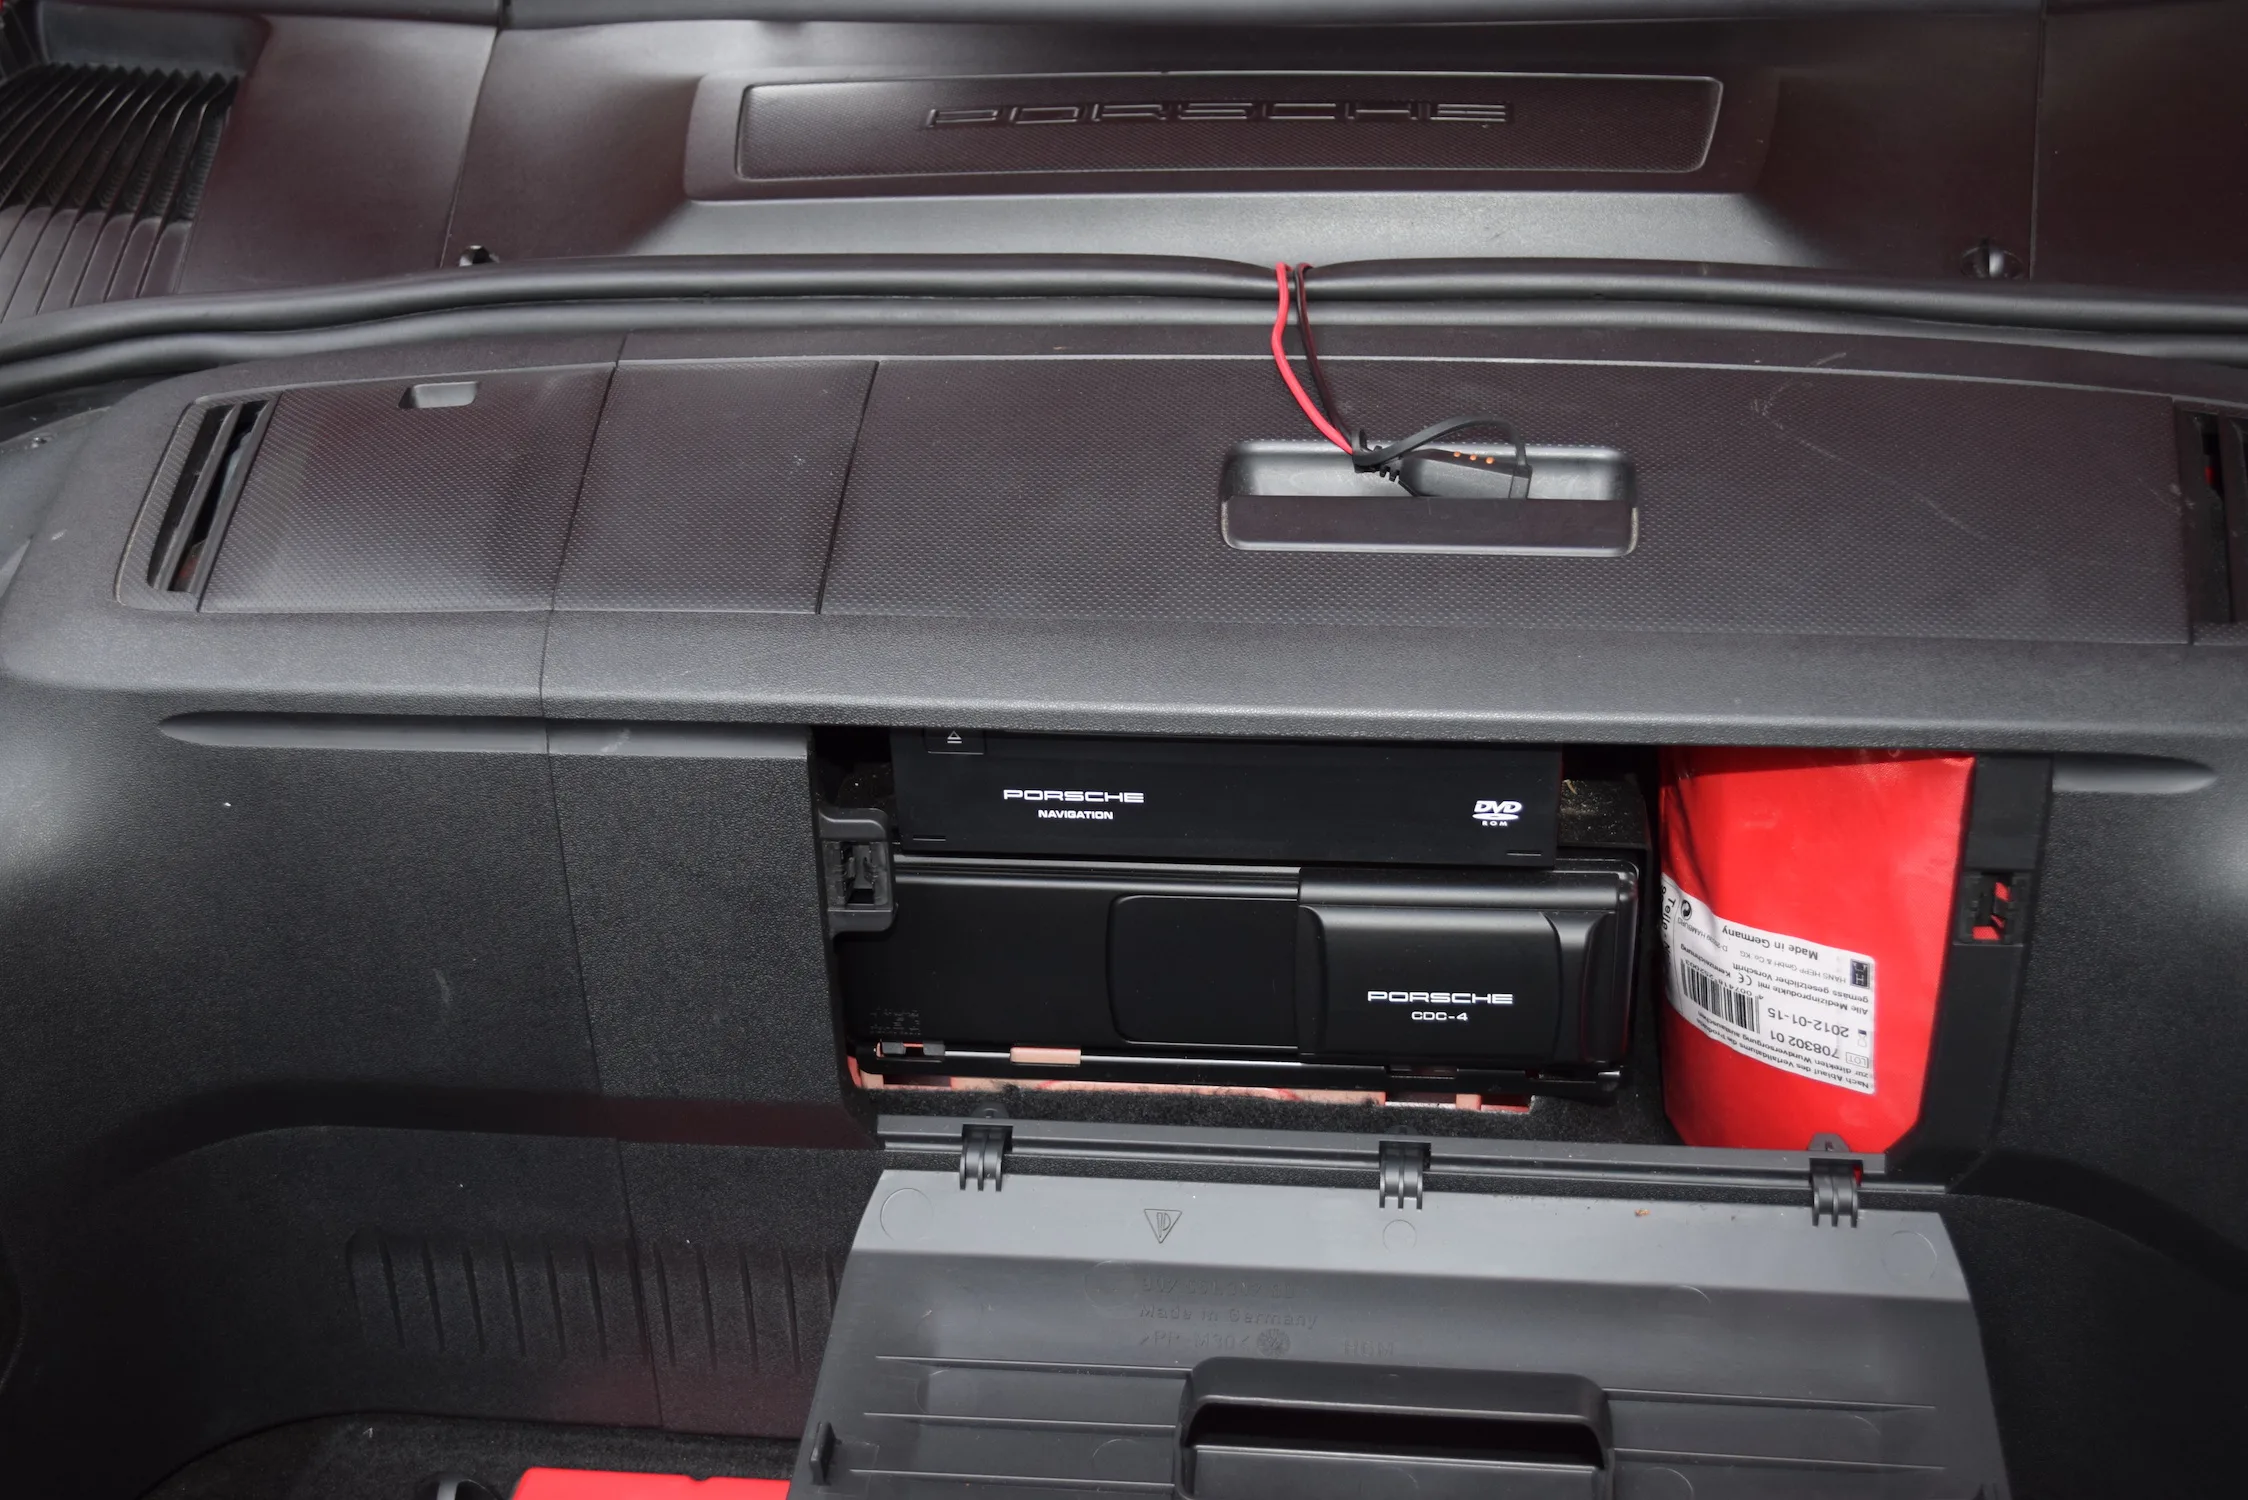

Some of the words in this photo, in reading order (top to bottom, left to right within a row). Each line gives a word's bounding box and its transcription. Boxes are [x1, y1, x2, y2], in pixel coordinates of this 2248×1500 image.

[922, 102, 1512, 128] PORSCHE
[1003, 789, 1145, 803] PORSCHE
[1473, 800, 1523, 814] DVD
[1038, 809, 1114, 820] NAVIGATION
[1722, 925, 1770, 949] Germany
[1774, 941, 1785, 952] in
[1788, 944, 1818, 960] Made
[1739, 950, 1751, 959] KG
[1732, 962, 1773, 981] Vorschrift
[1822, 972, 1846, 984] HANS
[1758, 981, 1770, 989] mit
[1775, 975, 1829, 994] gesetzlicher
[1367, 991, 1513, 1005] PORSCHE
[1772, 985, 1848, 1010] Medizinprodukte
[1411, 1011, 1468, 1021] CDC-4
[1851, 1005, 1868, 1015] Alle
[1767, 1007, 1849, 1038] 2012-01-15
[1770, 1030, 1785, 1043] 01
[1742, 1034, 1812, 1064] Wundversorgung
[1788, 1035, 1840, 1059] 708302
[1796, 1063, 1811, 1072] des
[1814, 1059, 1851, 1074] direkten
[1814, 1068, 1843, 1082] Ablauf
[1845, 1077, 1869, 1088] Nach
[1139, 1304, 1192, 1320] Made
[1201, 1308, 1219, 1322] in
[1229, 1308, 1319, 1330] Germany
